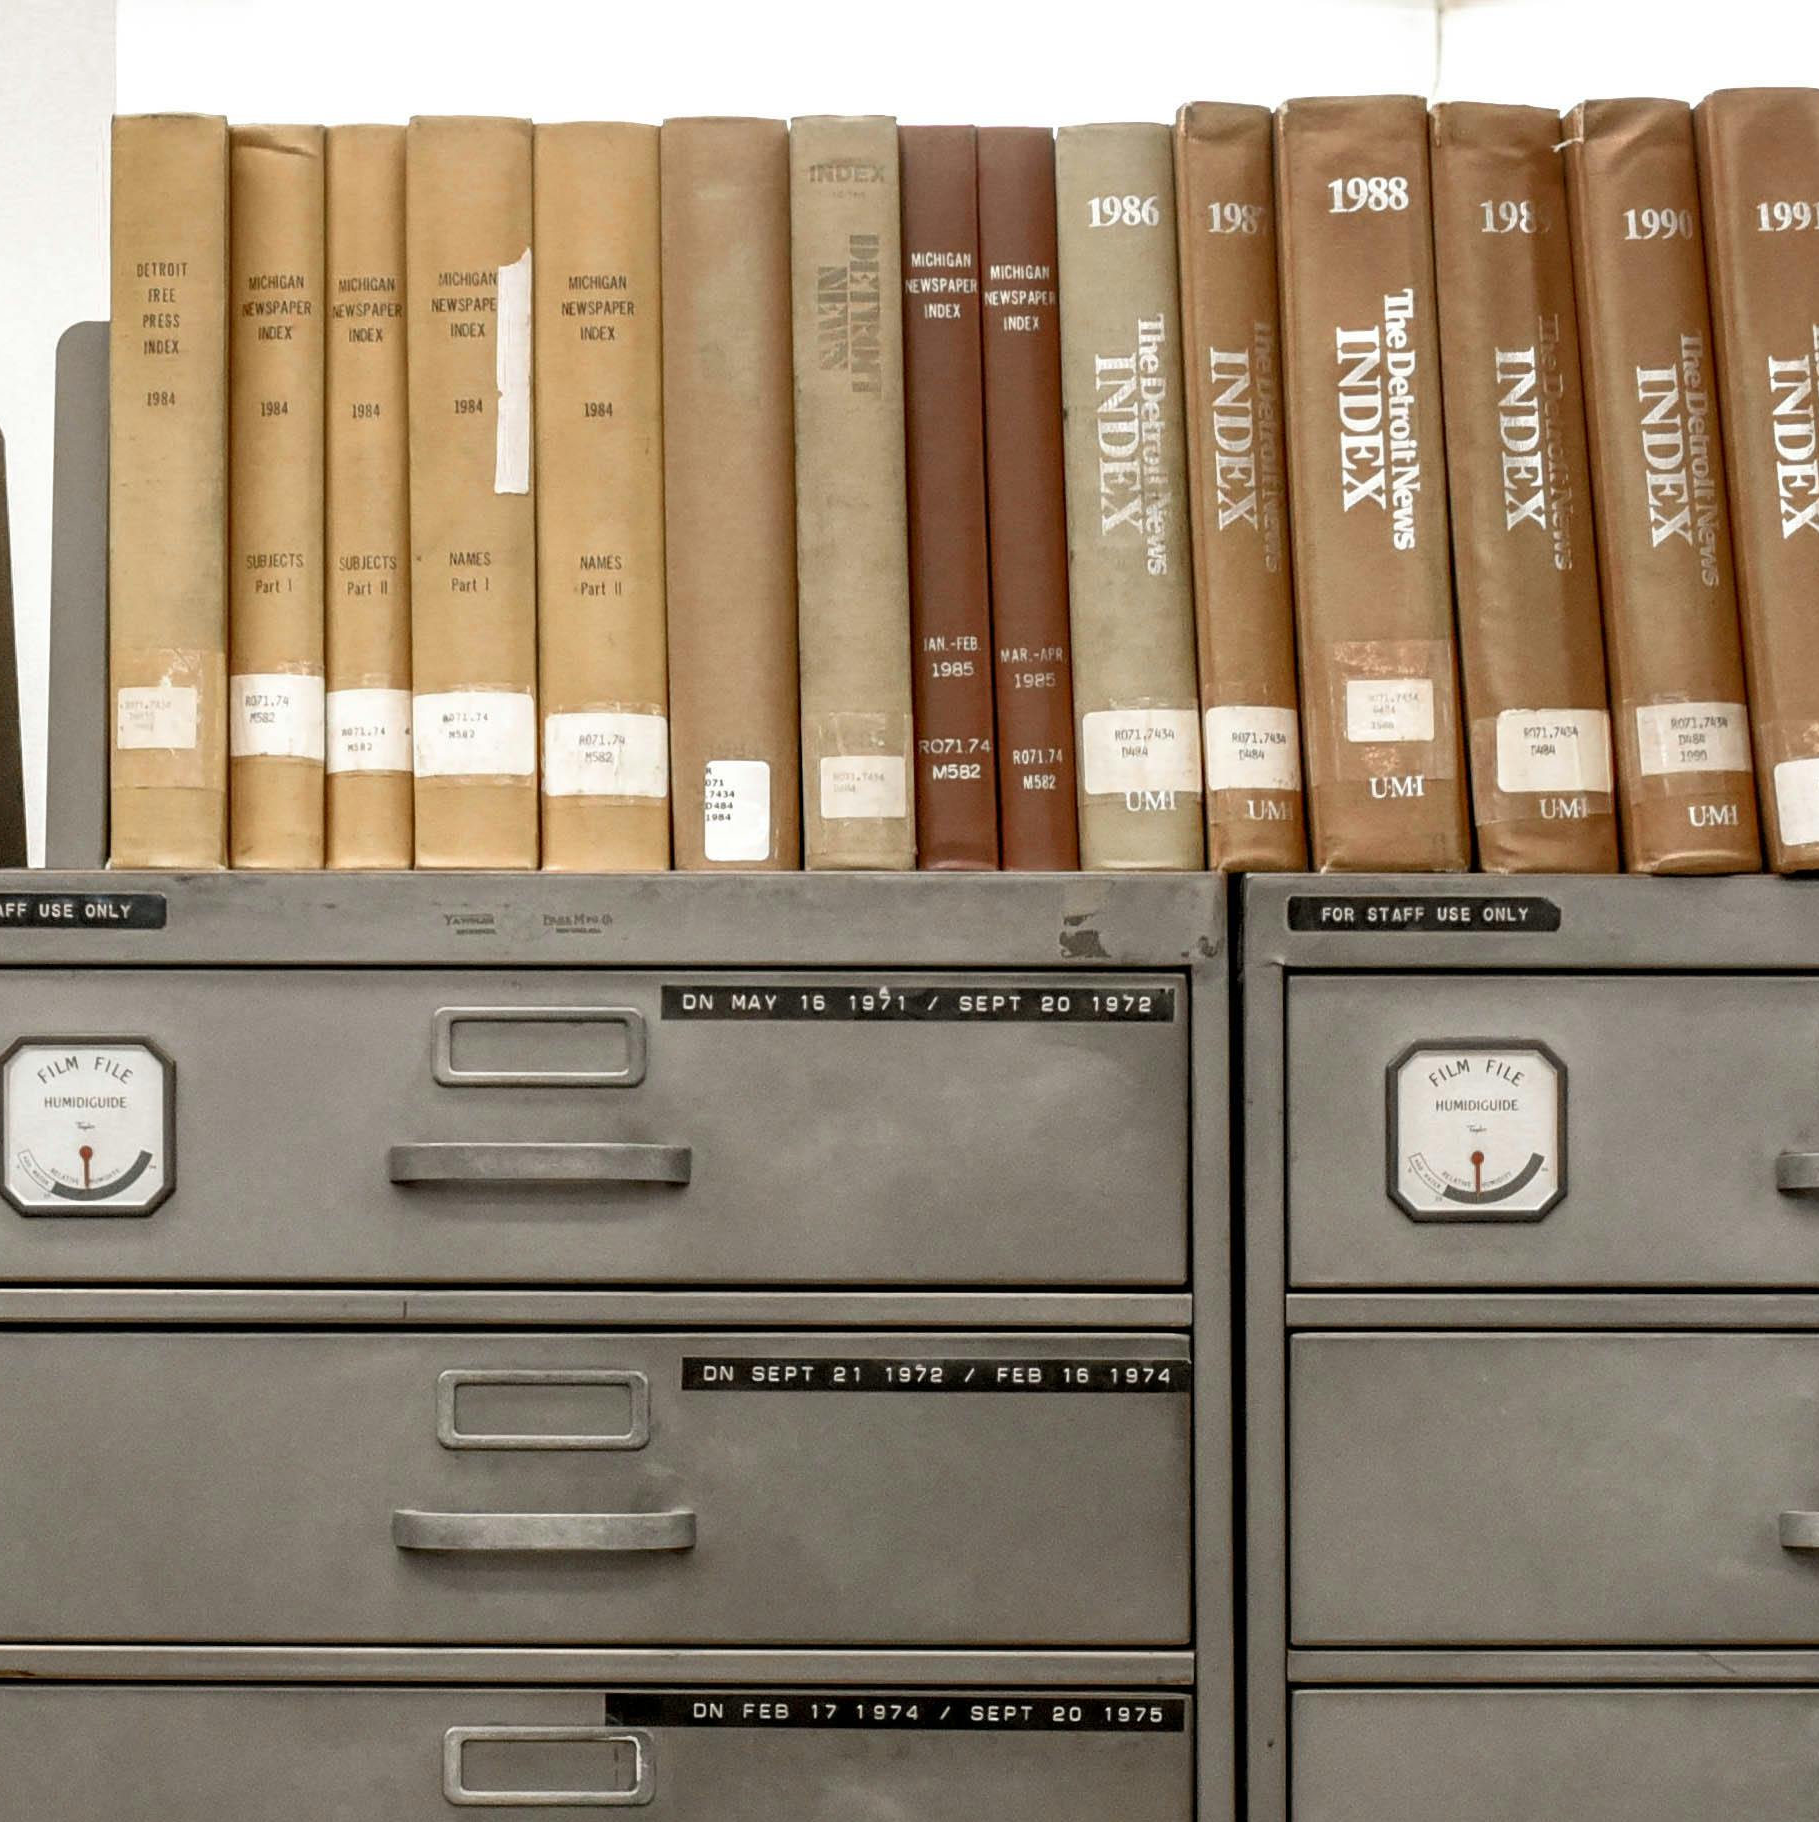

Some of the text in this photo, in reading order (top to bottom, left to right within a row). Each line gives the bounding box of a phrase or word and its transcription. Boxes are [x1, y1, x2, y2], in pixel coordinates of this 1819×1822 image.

[1327, 176, 1409, 214] 1988
[1088, 195, 1159, 228] 1986
[911, 251, 971, 268] MICHIGAN
[136, 261, 188, 278] DETROIT
[568, 275, 627, 290] MICHIGAN
[905, 278, 977, 294] NEWSPAPER
[561, 300, 635, 317] NEWSPAPER
[924, 303, 961, 319] INDEX
[142, 312, 180, 329] PRESS
[580, 326, 615, 341] INDEX
[143, 339, 179, 355] INDEX
[147, 391, 176, 407] 1984
[584, 402, 613, 418] 1984
[1335, 325, 1387, 513] INDEX
[1384, 288, 1421, 550] The Detroit News
[579, 555, 622, 570] NAMES
[580, 582, 606, 596] Part
[932, 661, 974, 678] 1985
[39, 902, 74, 919] USE
[84, 898, 131, 919] ONLY
[1321, 906, 1529, 922] FOR STAFF USE ONLY
[37, 1056, 133, 1084] FILM FILE
[1429, 1059, 1525, 1087] FILM FILE
[44, 1096, 127, 1108] HUMIDIGUIDE
[1436, 1099, 1518, 1111] HUMIDIGUIDE
